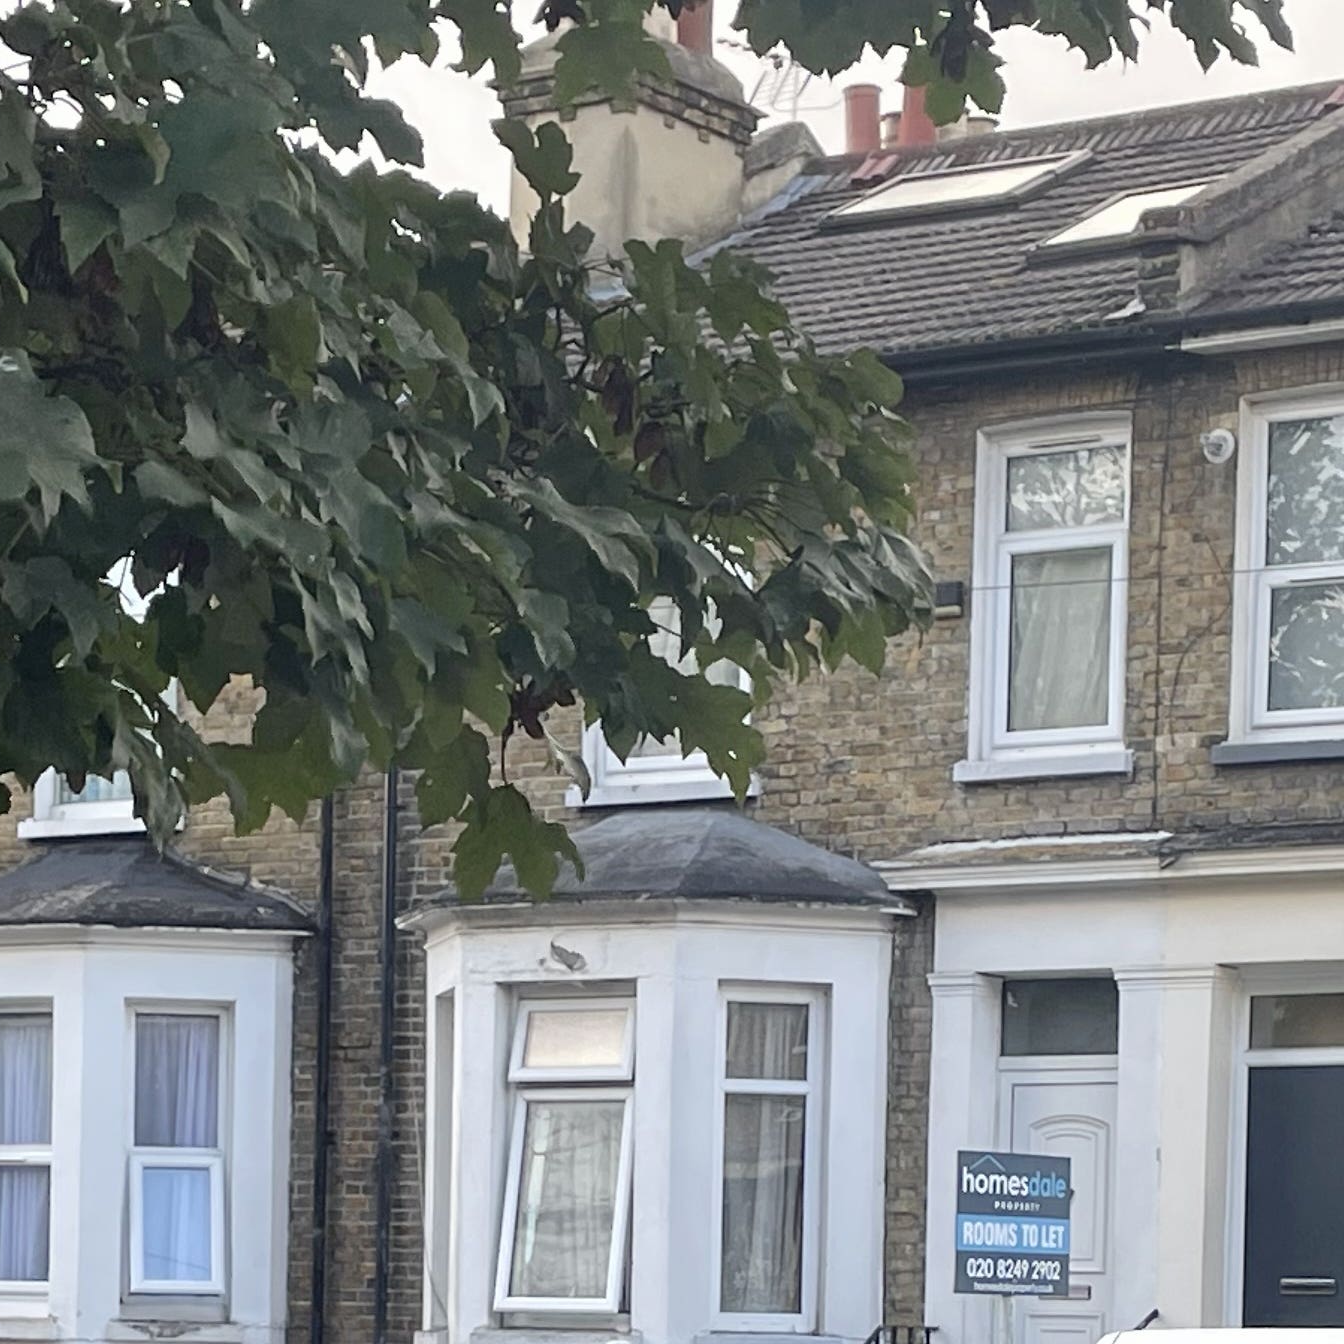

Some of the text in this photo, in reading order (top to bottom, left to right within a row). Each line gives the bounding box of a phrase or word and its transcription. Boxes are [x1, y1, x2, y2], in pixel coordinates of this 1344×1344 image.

[962, 1165, 1067, 1199] homesdale
[963, 1221, 1065, 1249] ROOMS TO LET
[966, 1257, 1062, 1281] 020 8249 2902
